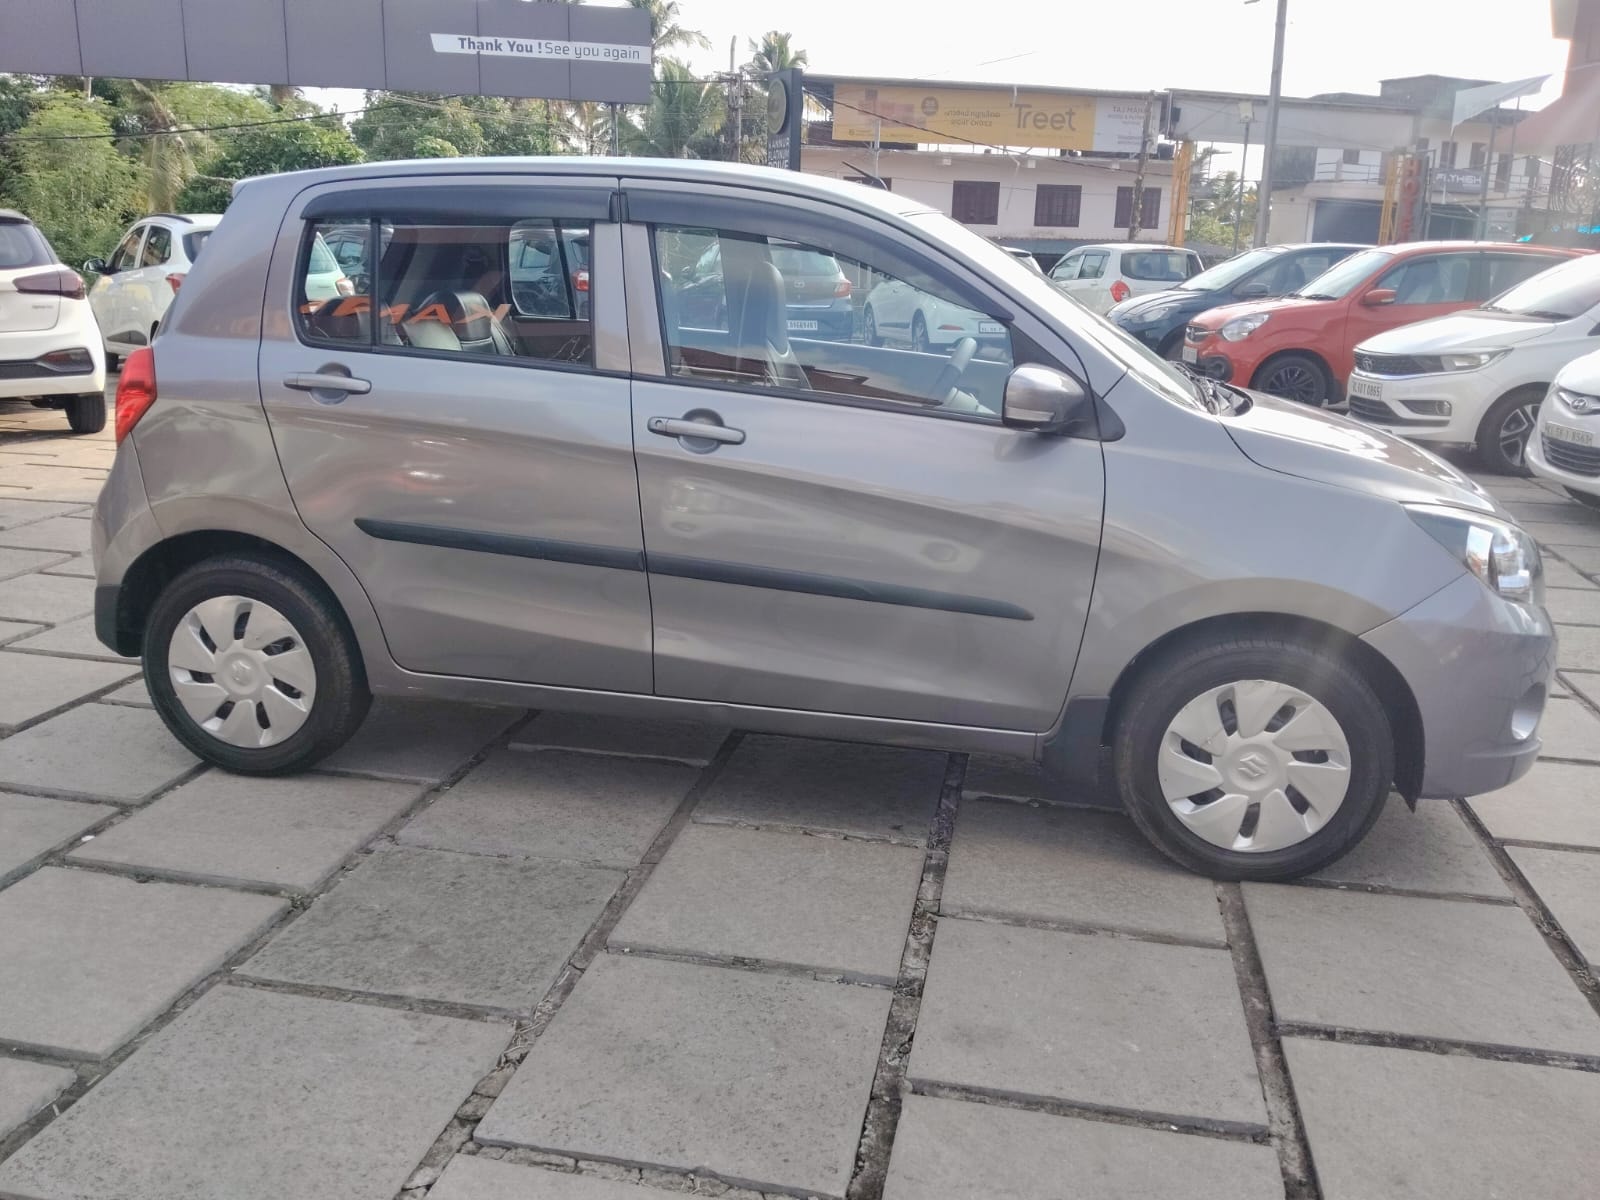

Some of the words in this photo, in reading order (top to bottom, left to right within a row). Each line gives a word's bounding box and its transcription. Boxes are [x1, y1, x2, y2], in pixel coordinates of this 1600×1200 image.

[457, 37, 503, 52] Thank
[507, 40, 533, 53] You
[544, 42, 570, 55] See
[574, 46, 599, 58] you
[603, 46, 640, 60] again
[1009, 103, 1076, 131] Treet
